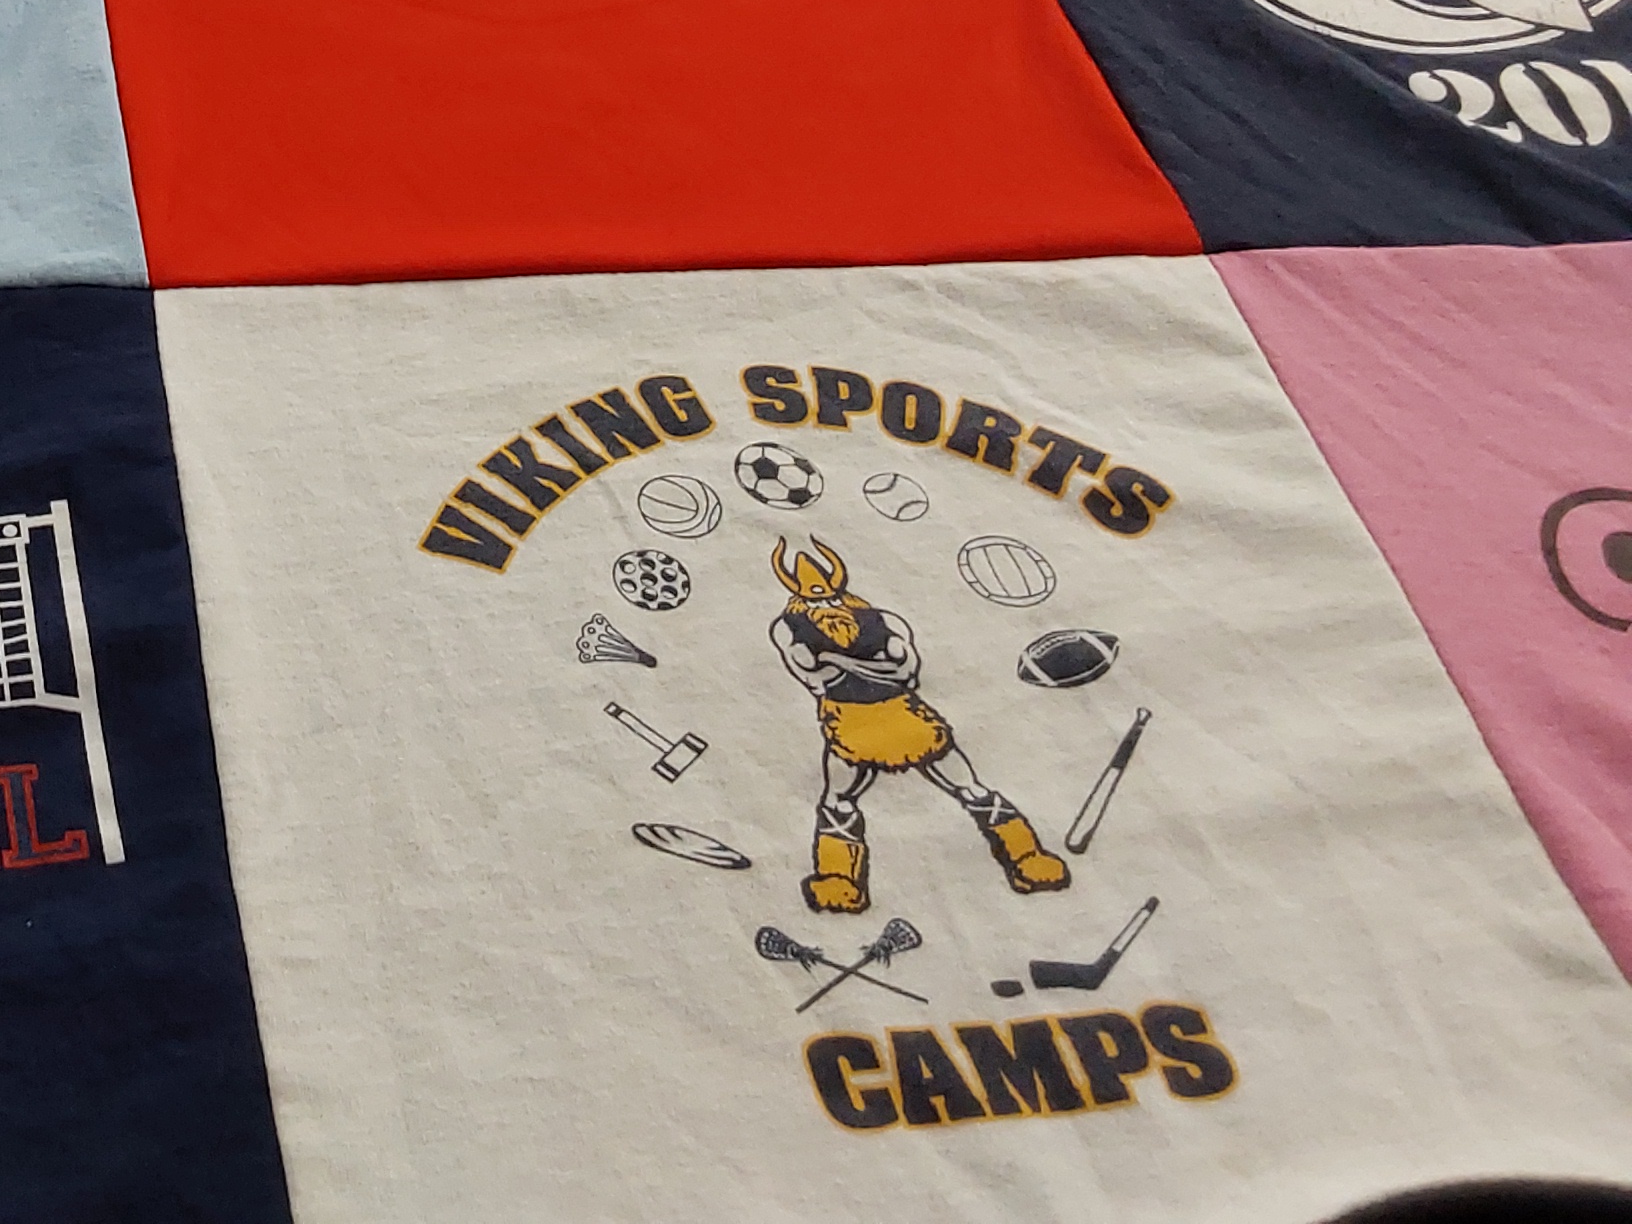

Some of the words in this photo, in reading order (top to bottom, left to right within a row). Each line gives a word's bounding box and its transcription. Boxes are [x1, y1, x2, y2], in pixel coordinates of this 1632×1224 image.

[418, 374, 718, 575] VIKING
[738, 362, 1176, 542] SPORTS
[803, 998, 1240, 1133] CAMPS
